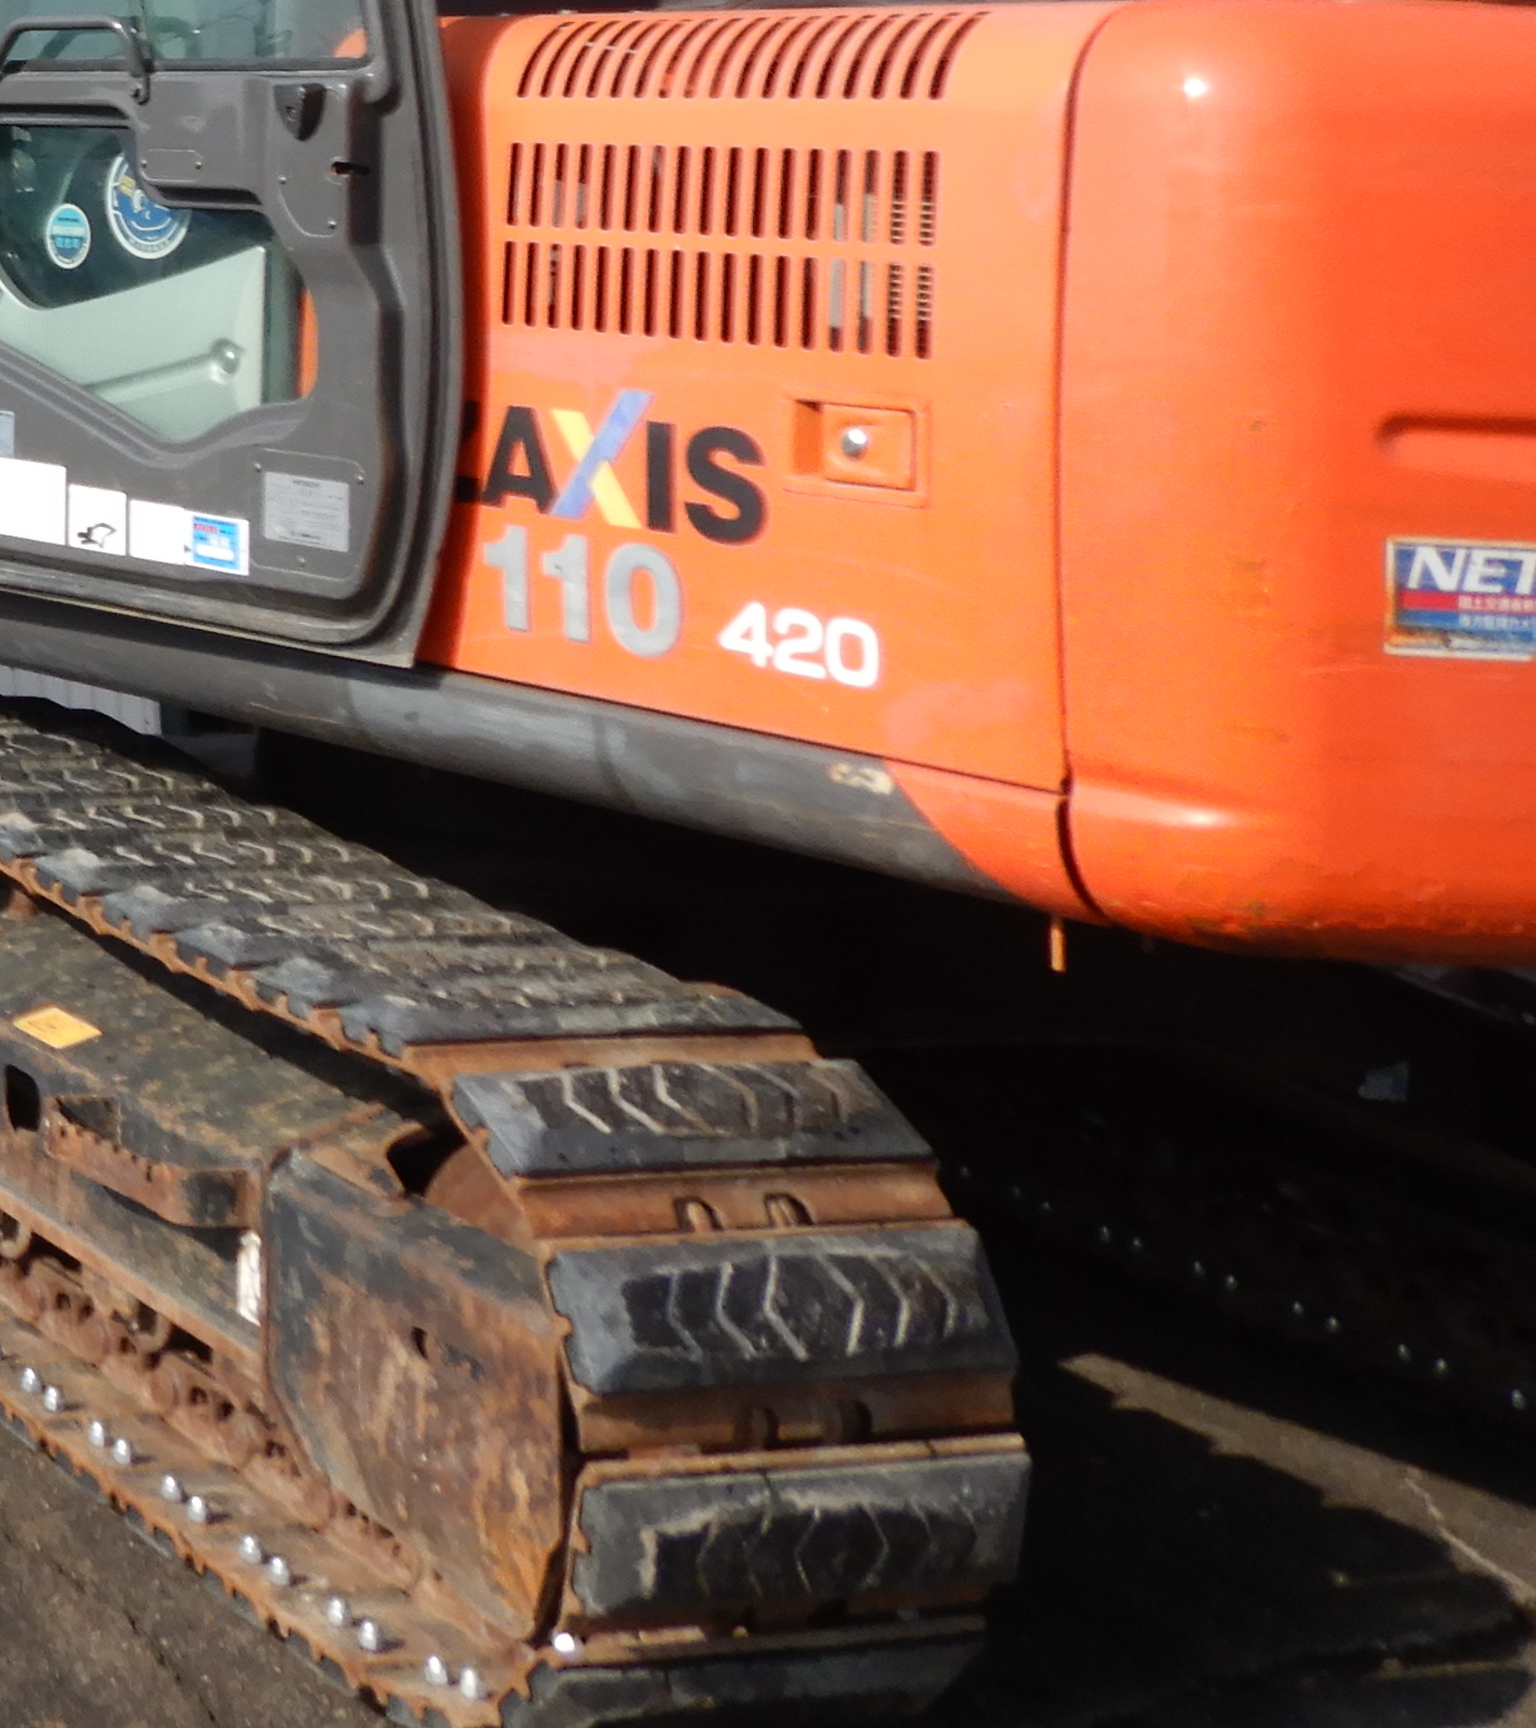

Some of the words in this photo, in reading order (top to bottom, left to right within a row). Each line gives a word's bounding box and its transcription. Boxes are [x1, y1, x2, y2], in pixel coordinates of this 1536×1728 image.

[455, 390, 765, 545] AXIS
[485, 525, 683, 658] 110
[718, 602, 880, 688] 420
